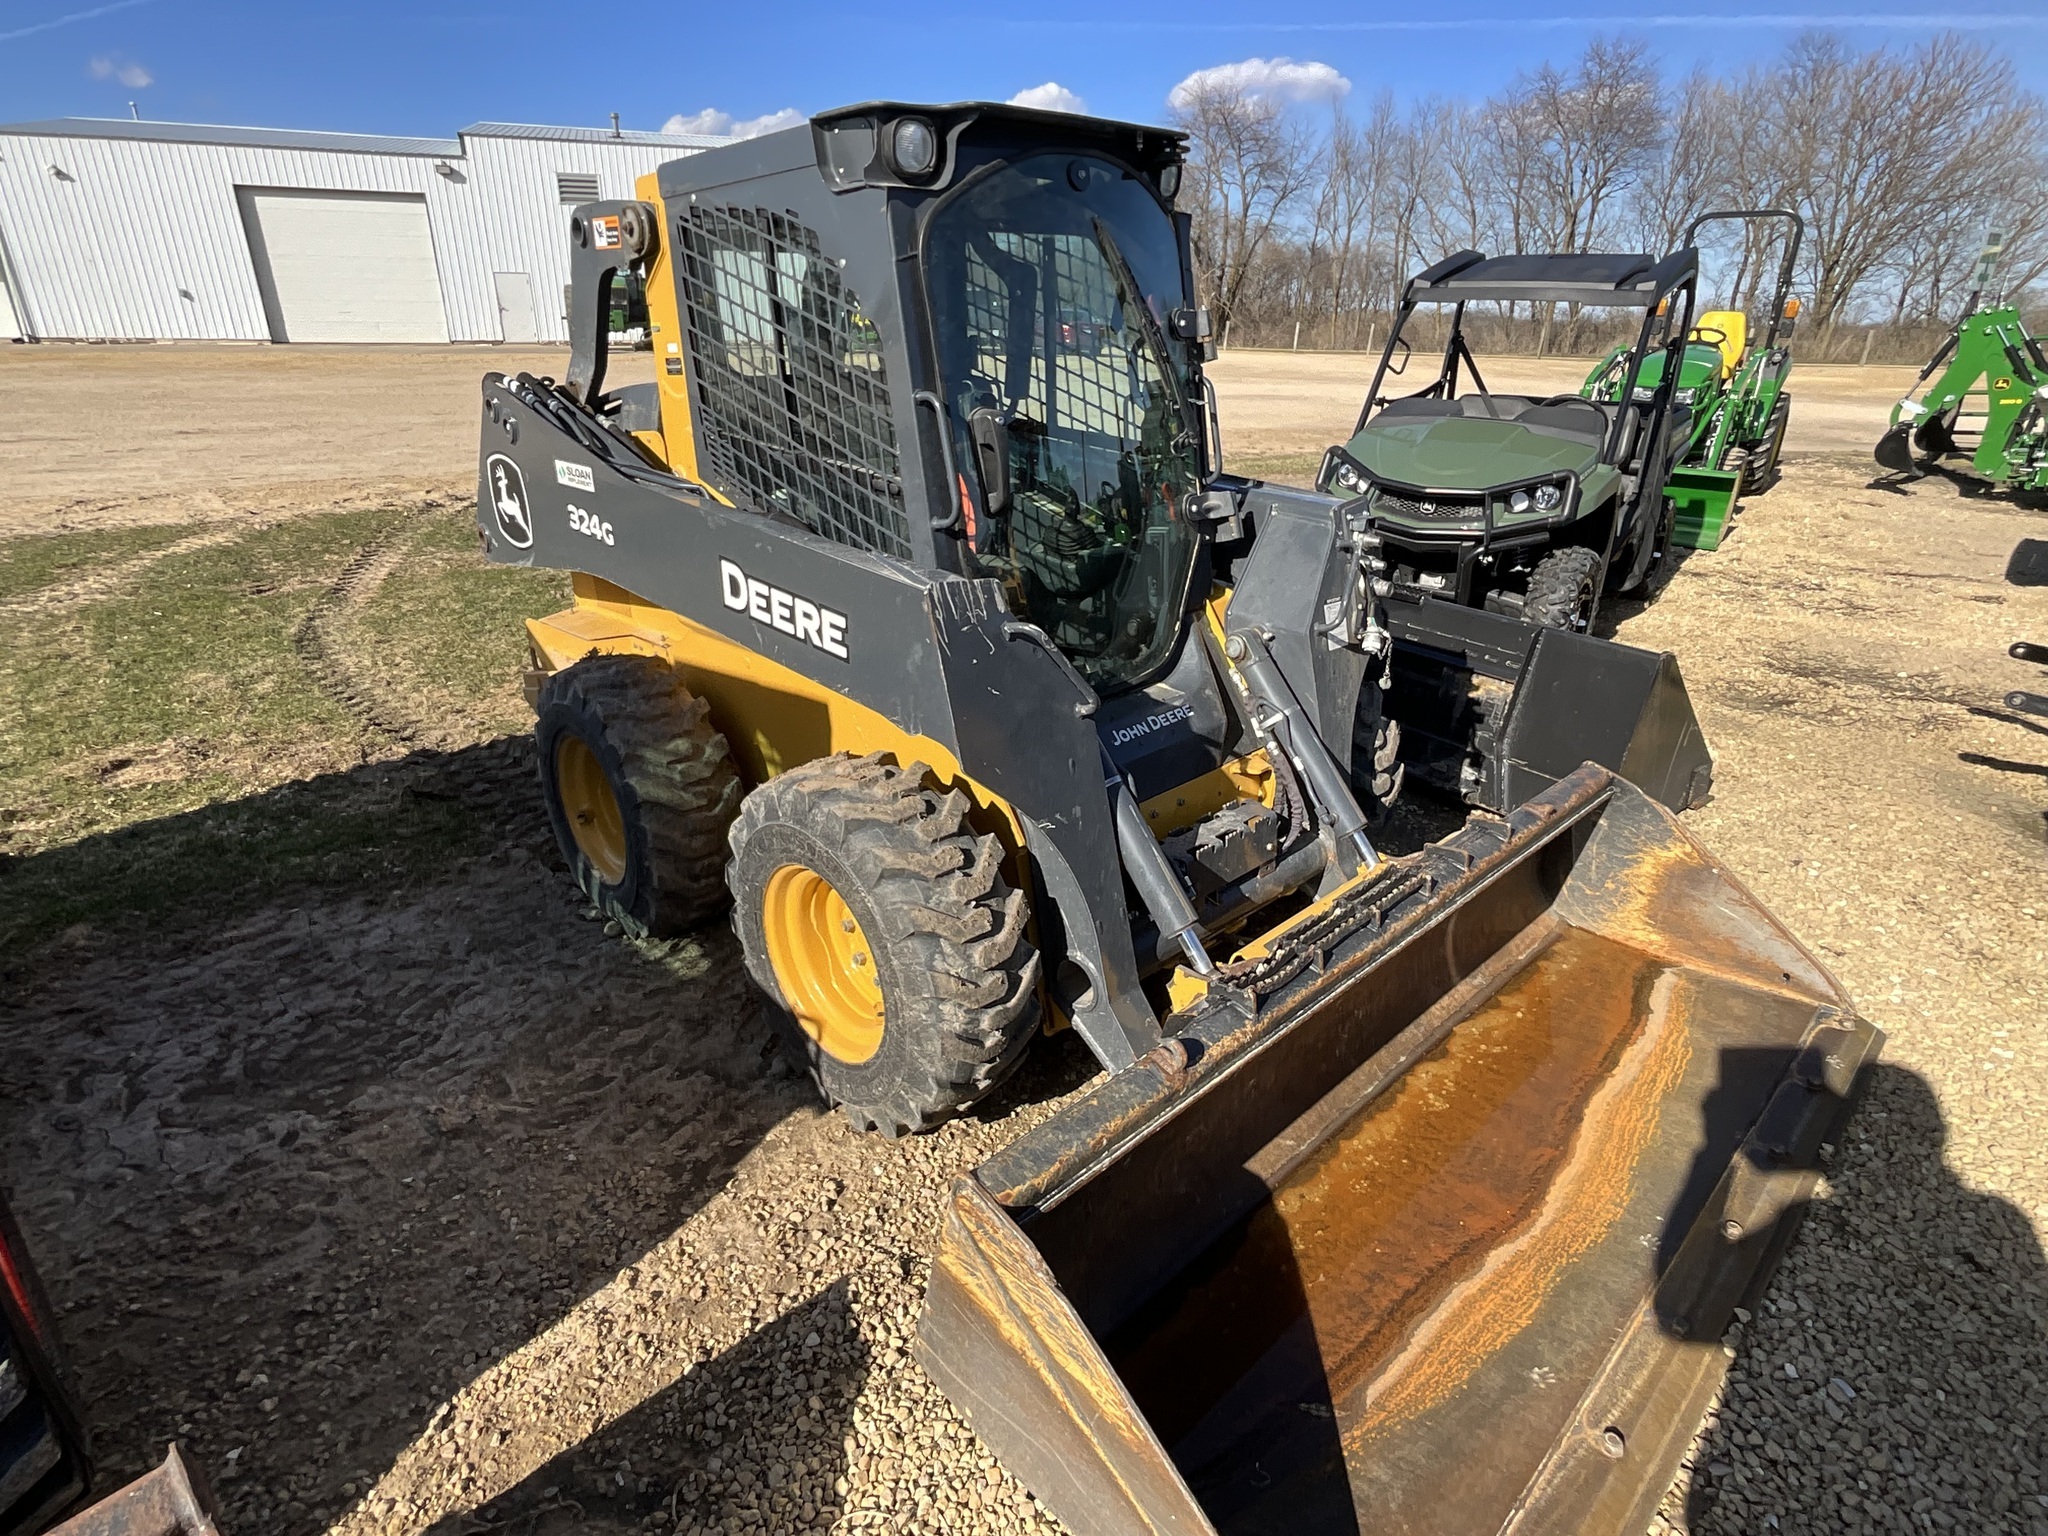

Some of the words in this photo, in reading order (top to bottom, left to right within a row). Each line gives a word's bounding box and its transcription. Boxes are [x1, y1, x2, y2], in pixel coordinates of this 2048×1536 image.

[566, 466, 591, 481] SLOAN
[567, 504, 615, 546] 324G
[720, 559, 848, 659] DEERE
[1112, 721, 1150, 746] JOHN
[1147, 704, 1195, 731] DEERE
